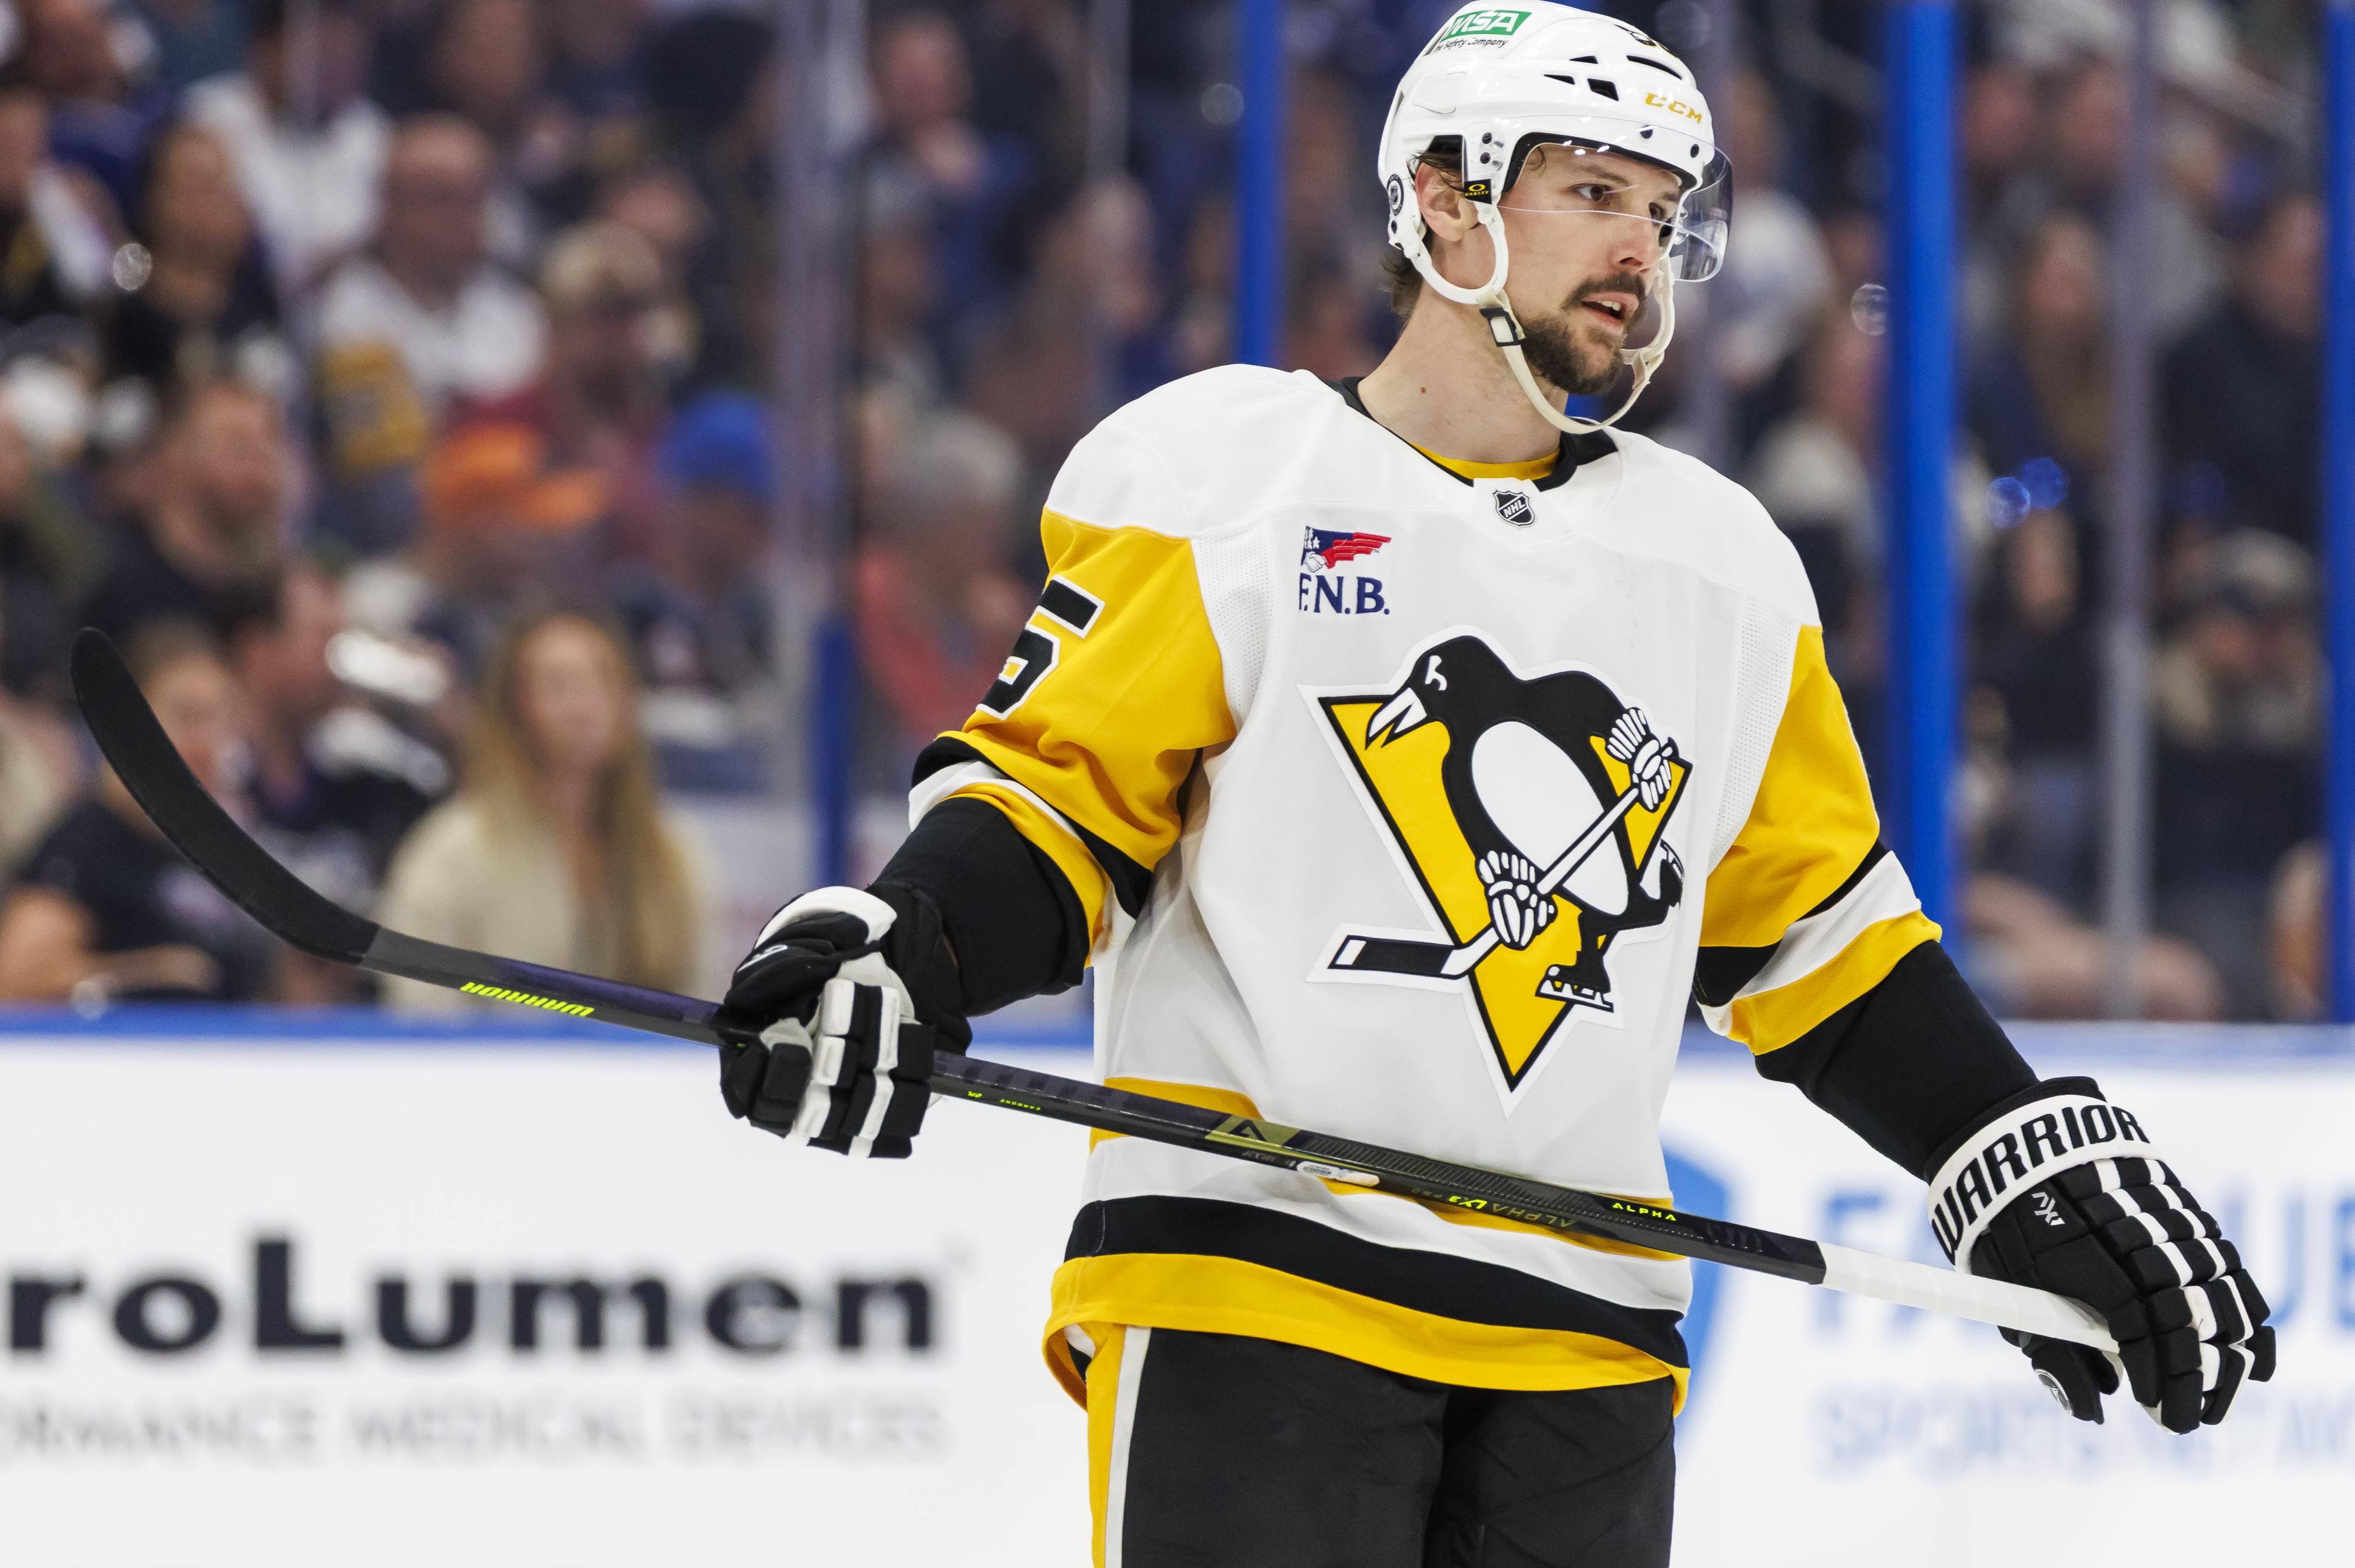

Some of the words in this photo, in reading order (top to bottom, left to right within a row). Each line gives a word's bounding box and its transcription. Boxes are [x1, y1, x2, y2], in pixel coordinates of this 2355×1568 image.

[1442, 12, 1520, 38] MSA
[1645, 92, 1702, 123] CCM
[1503, 500, 1525, 517] NHL
[1299, 573, 1390, 615] F.N.B.
[460, 982, 595, 1017] WARRIOR
[1932, 1105, 2150, 1266] WARRIOR
[1492, 1202, 1577, 1227] ALPHA
[1612, 1202, 1677, 1221] ALPHA
